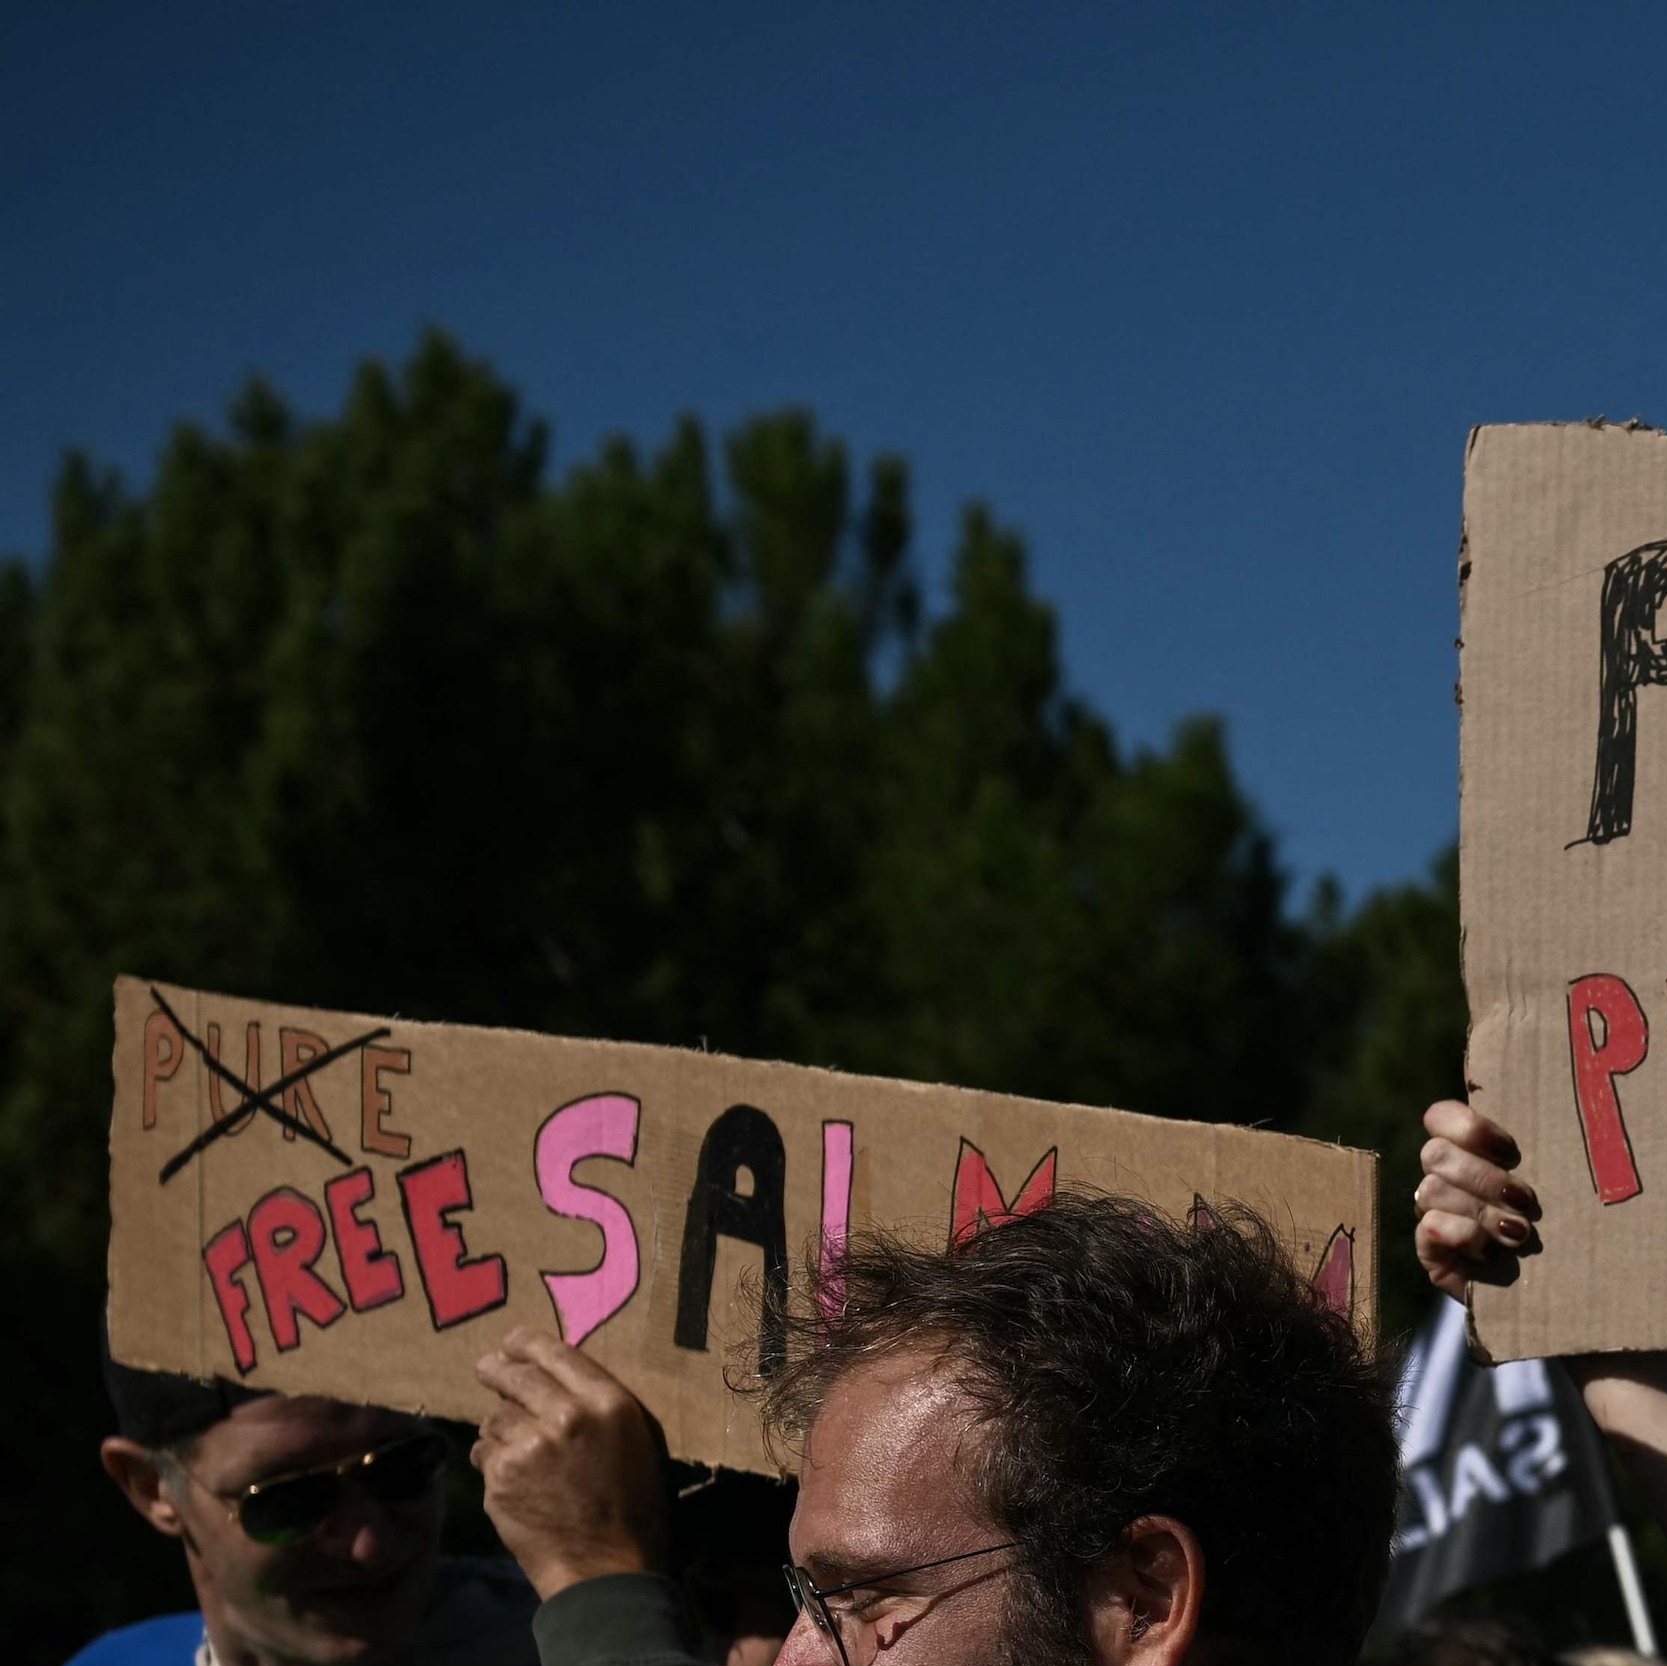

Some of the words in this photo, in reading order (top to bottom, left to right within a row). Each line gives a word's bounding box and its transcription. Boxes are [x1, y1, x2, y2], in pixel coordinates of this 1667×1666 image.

[142, 1006, 412, 1160] PURE
[202, 1149, 508, 1374] FREE
[534, 1090, 1357, 1377] SAL
